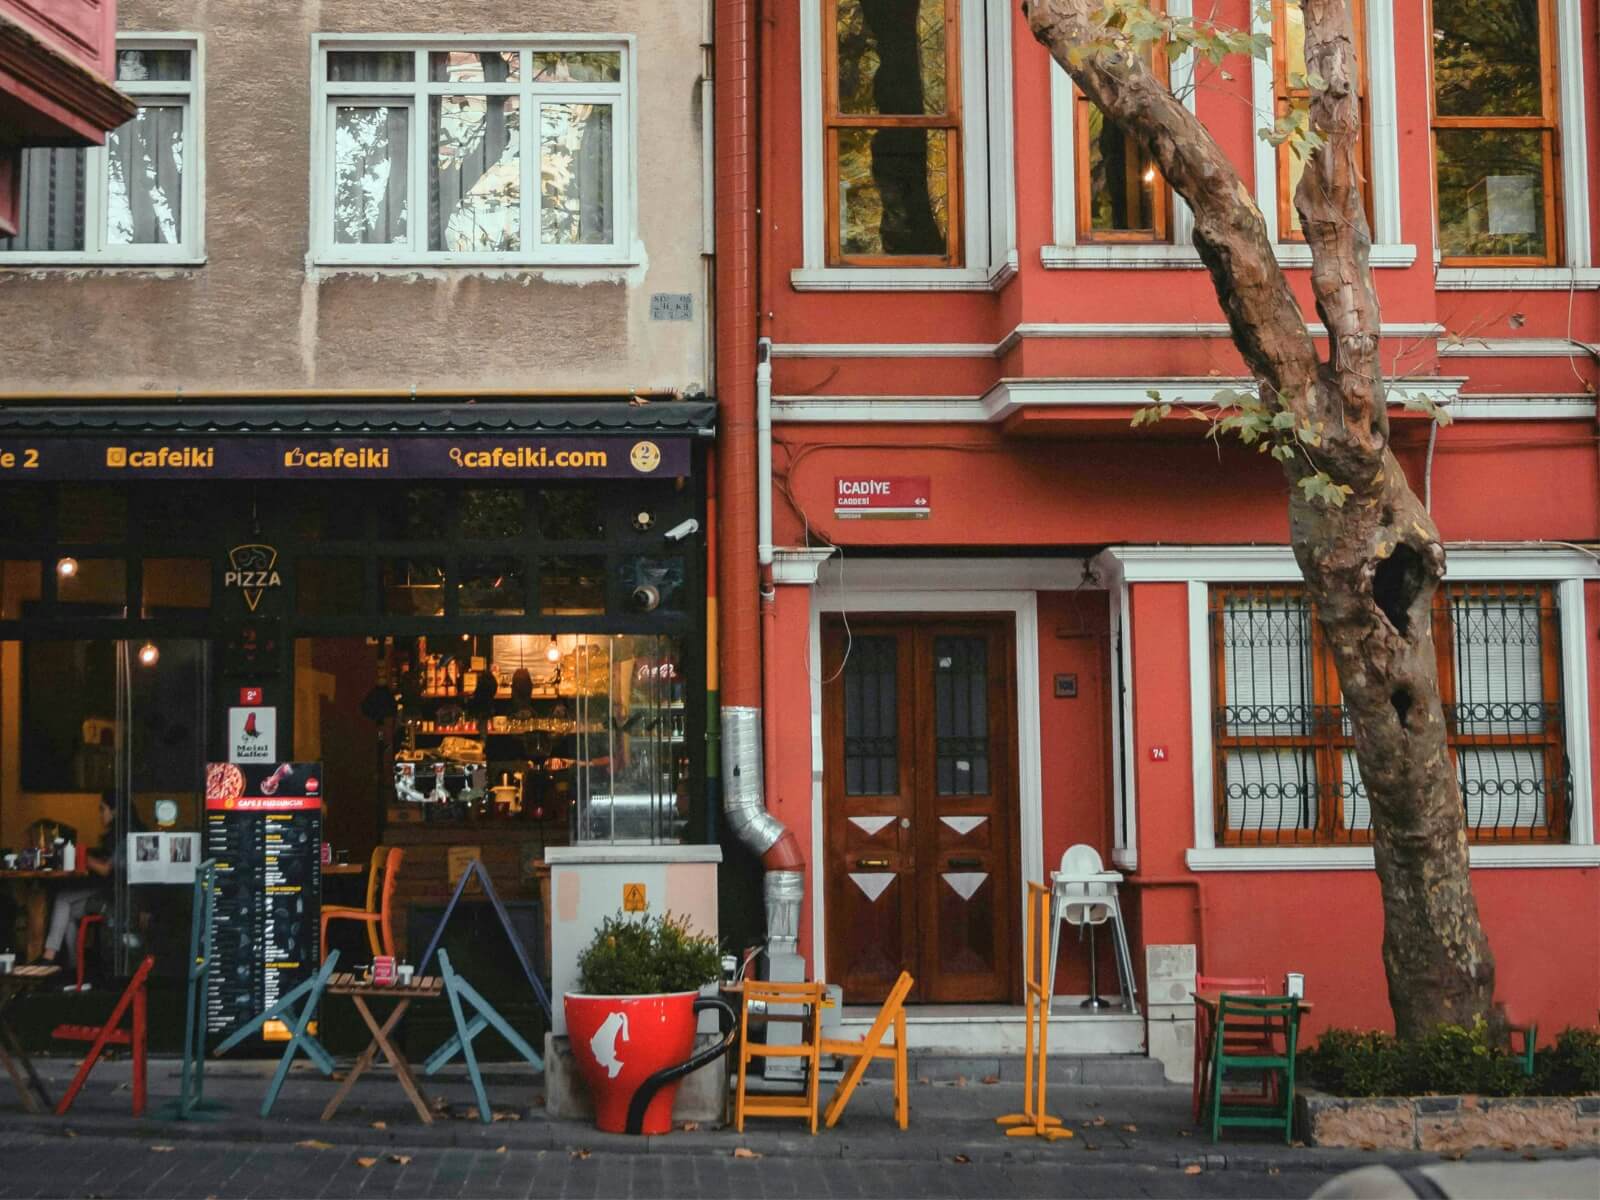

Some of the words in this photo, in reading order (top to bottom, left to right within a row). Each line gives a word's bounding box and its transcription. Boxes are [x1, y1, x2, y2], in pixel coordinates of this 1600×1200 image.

[24, 449, 39, 468] 2
[129, 447, 214, 468] cafeiki
[305, 447, 389, 468] cafeiki
[464, 447, 607, 468] cafeiki.com
[641, 446, 650, 459] 2
[838, 479, 891, 495] İCADİYE
[1153, 748, 1164, 759] 74
